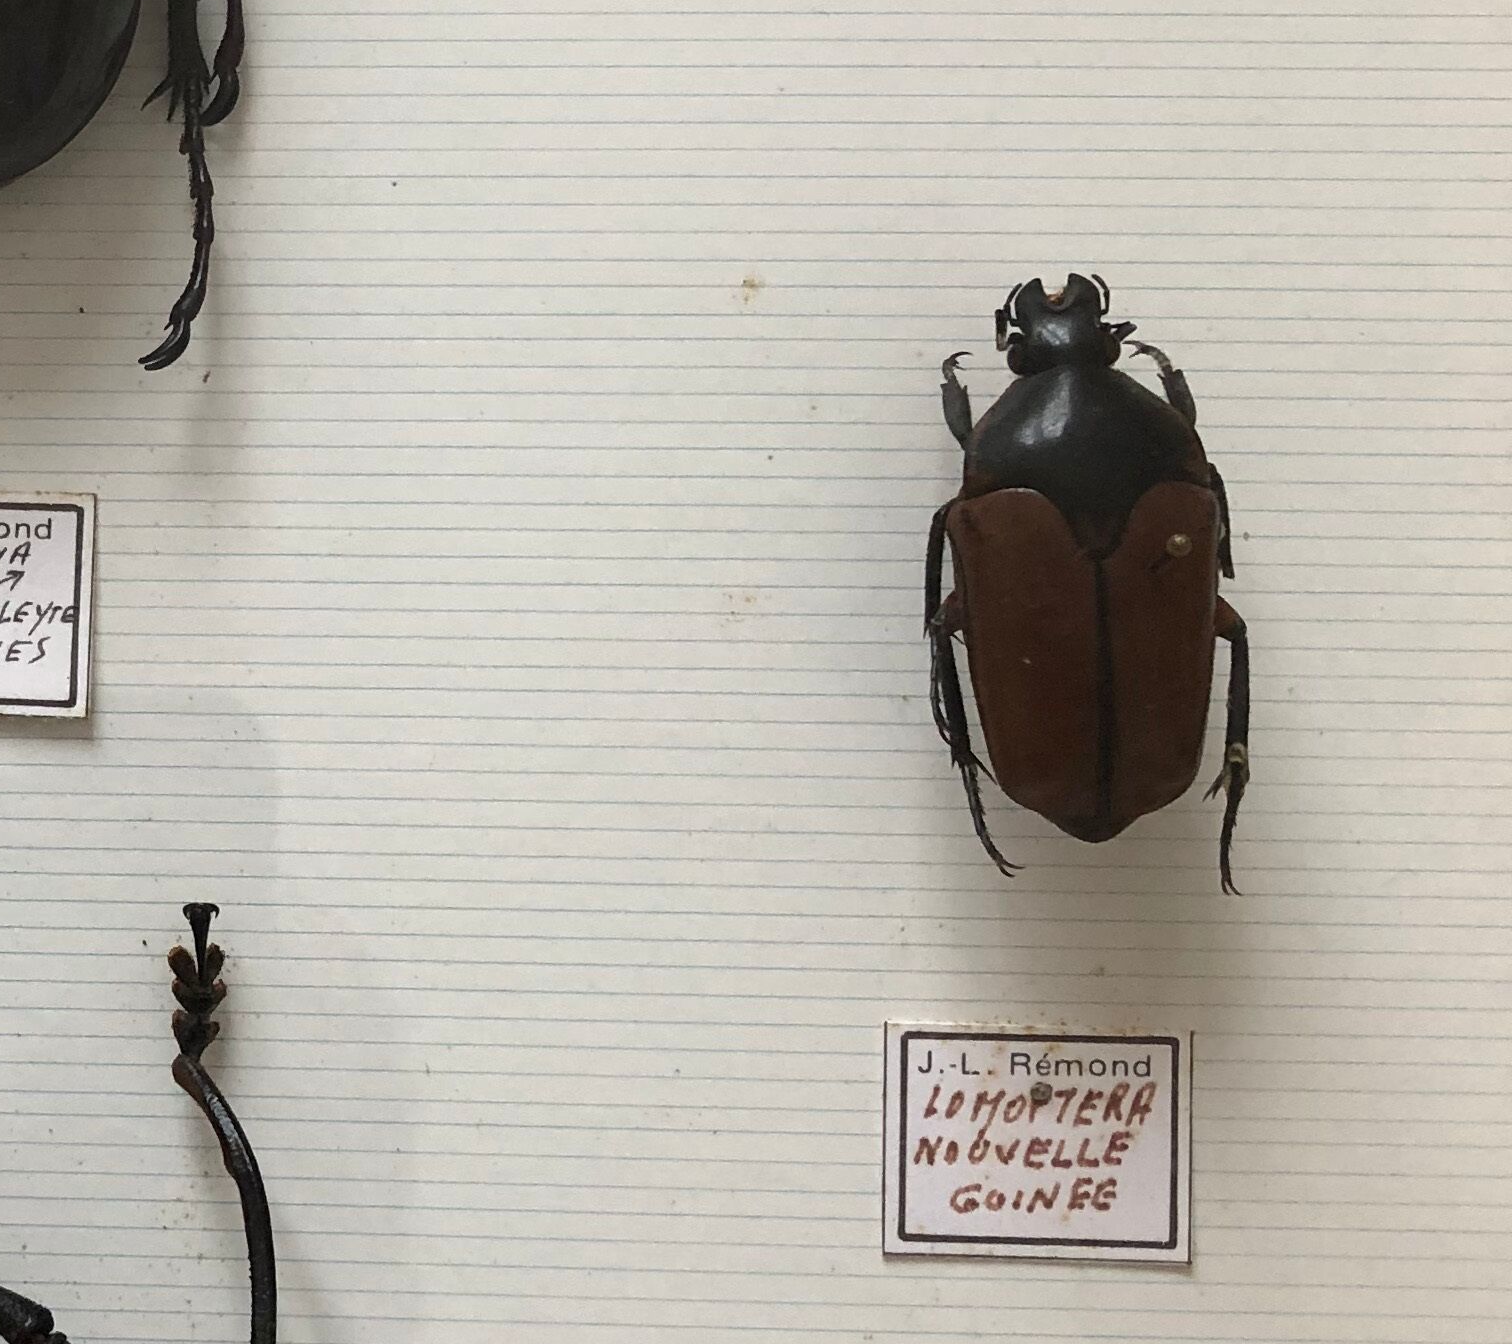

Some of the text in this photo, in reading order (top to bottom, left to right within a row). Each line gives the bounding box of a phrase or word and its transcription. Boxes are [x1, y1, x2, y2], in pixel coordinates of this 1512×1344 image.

[918, 1050, 1152, 1077] J.-L. Rémond
[914, 1130, 1133, 1169] NOUVELLE
